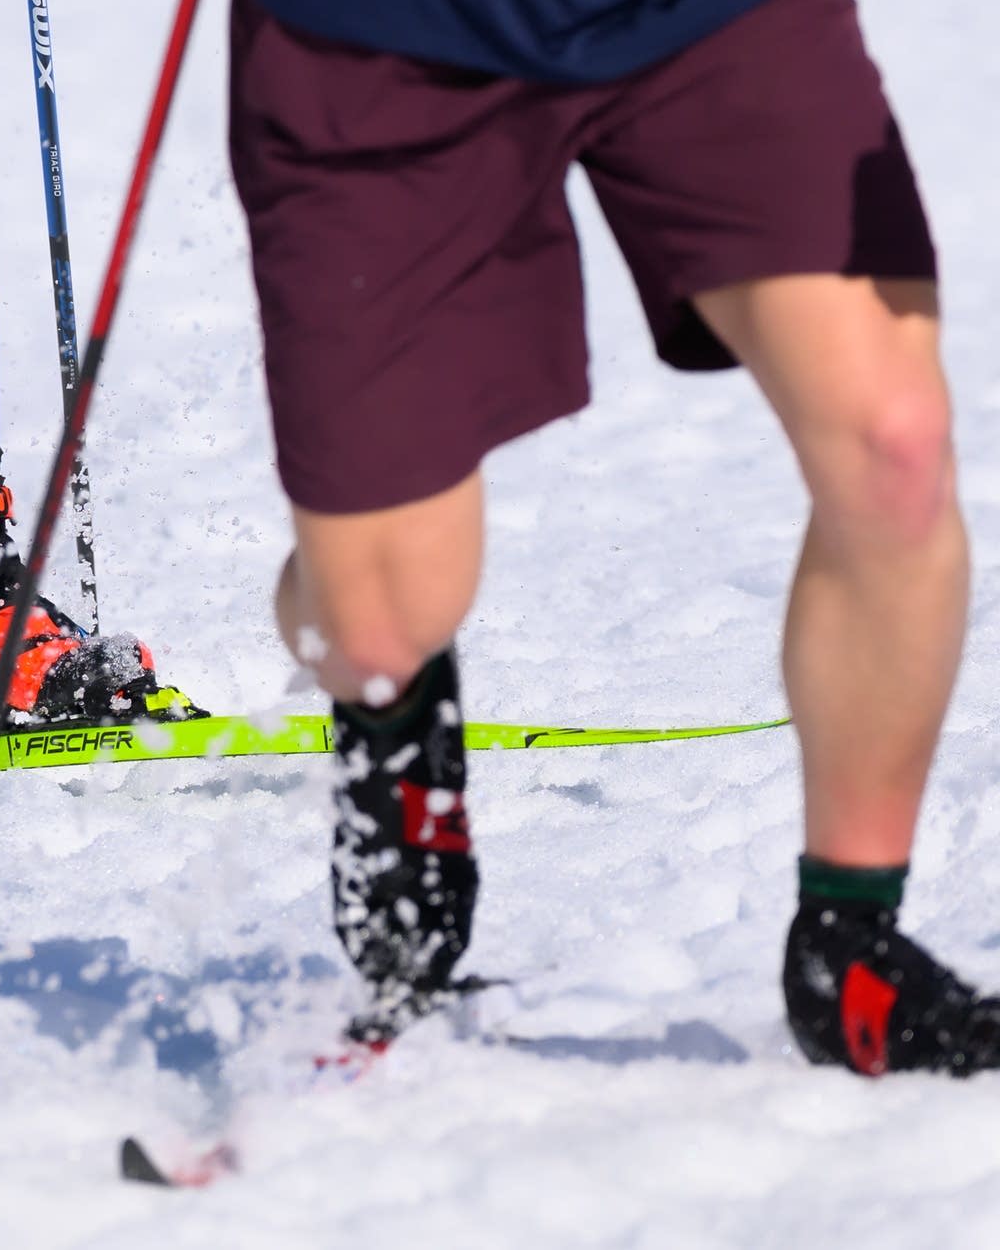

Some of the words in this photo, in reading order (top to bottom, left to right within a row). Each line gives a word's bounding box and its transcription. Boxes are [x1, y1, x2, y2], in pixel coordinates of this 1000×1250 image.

[50, 144, 60, 172] TRIAC
[52, 175, 62, 197] GIRO
[26, 730, 134, 756] FISCHER
